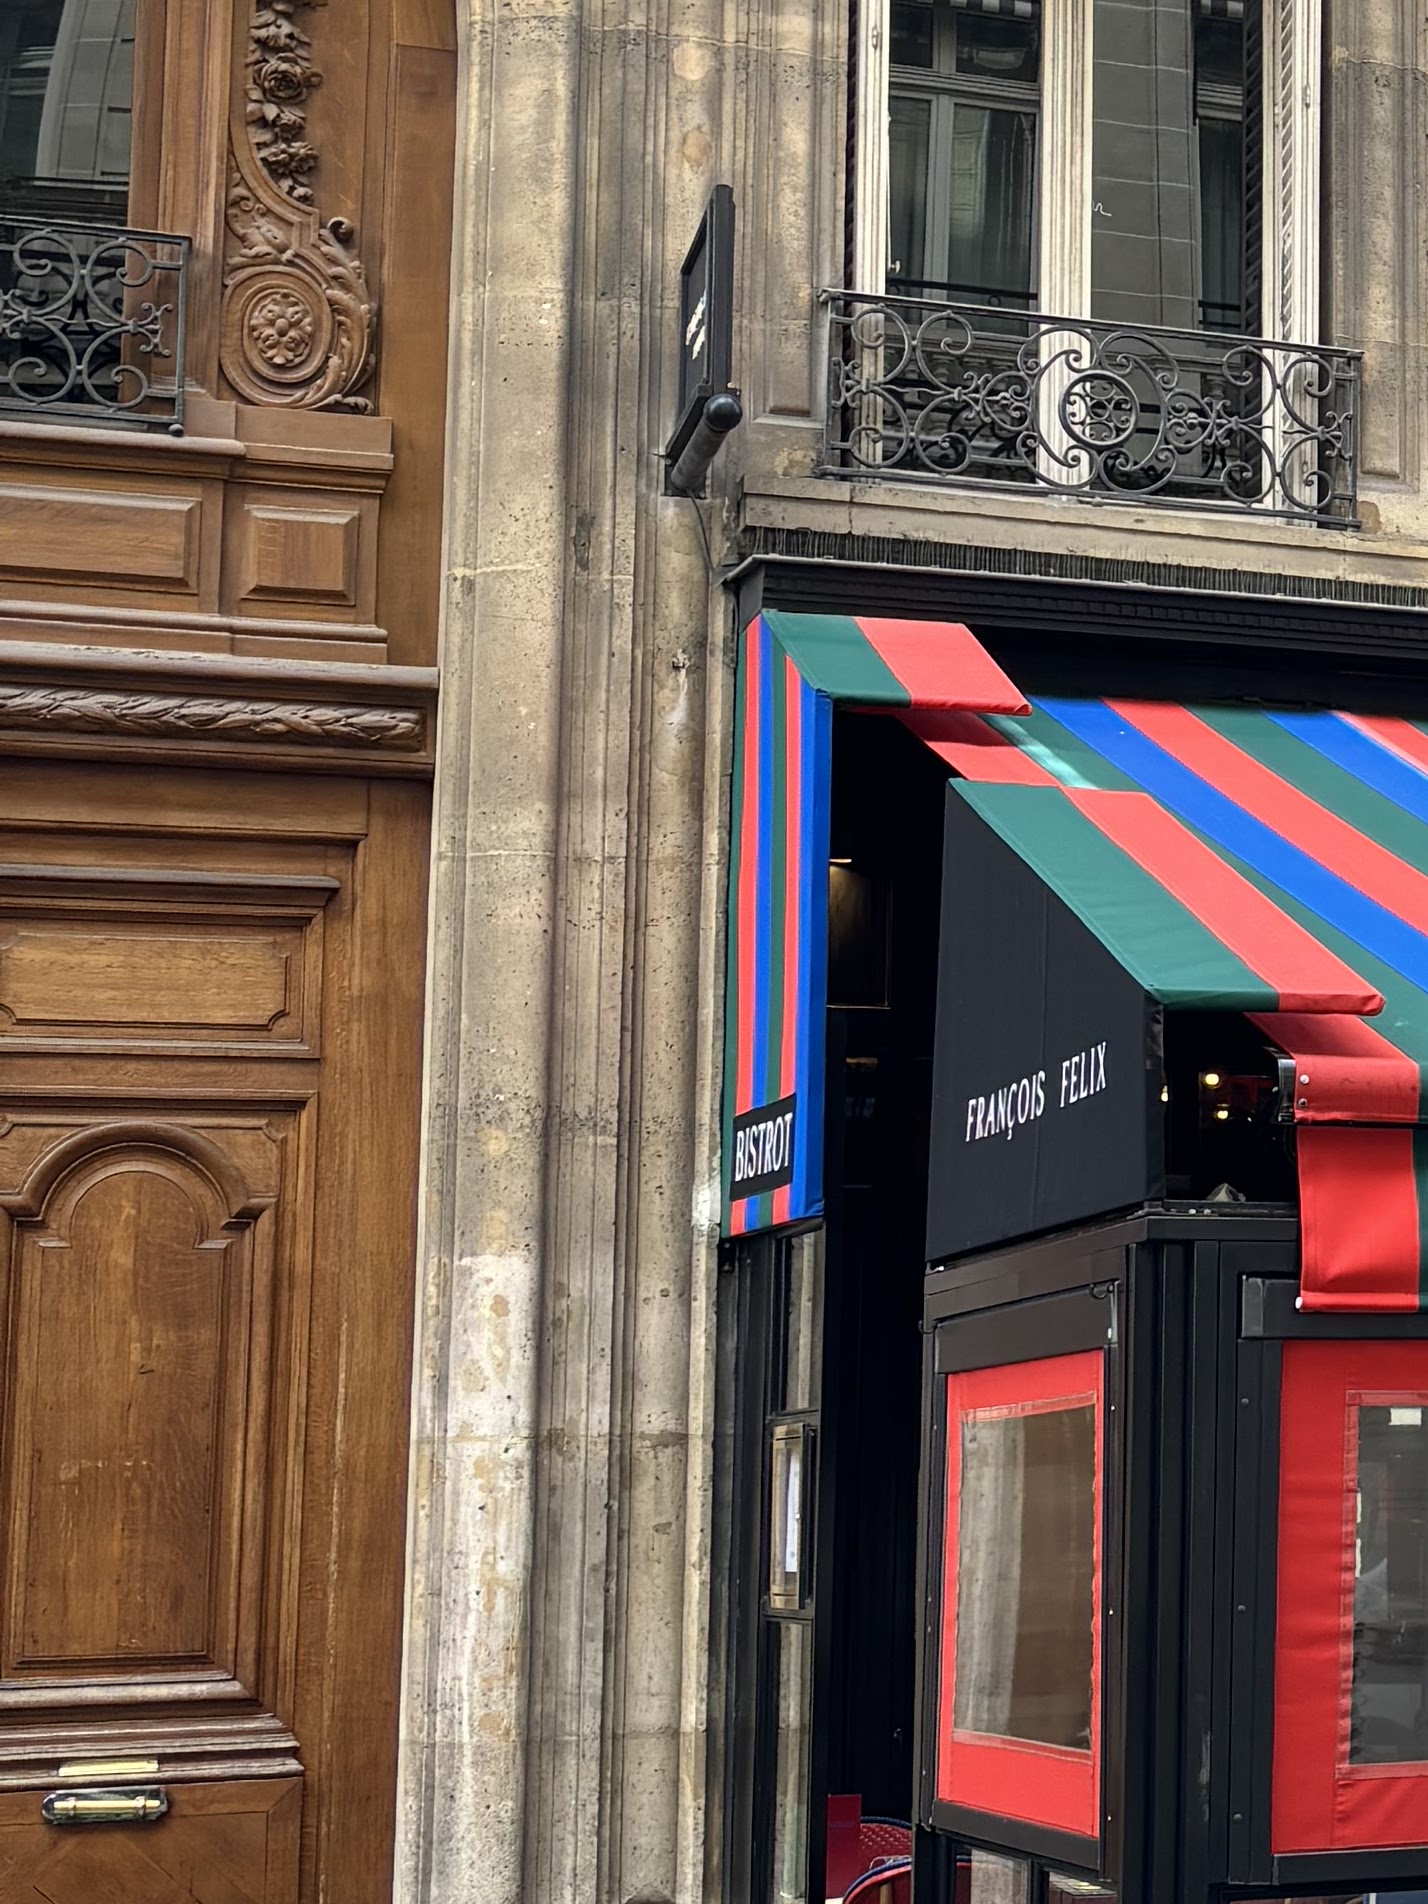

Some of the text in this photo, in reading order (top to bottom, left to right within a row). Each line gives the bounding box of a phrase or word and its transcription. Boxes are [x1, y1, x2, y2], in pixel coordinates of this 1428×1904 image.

[965, 1041, 1106, 1142] FRANÇOIS FELIX
[734, 1112, 793, 1182] BISTROT
